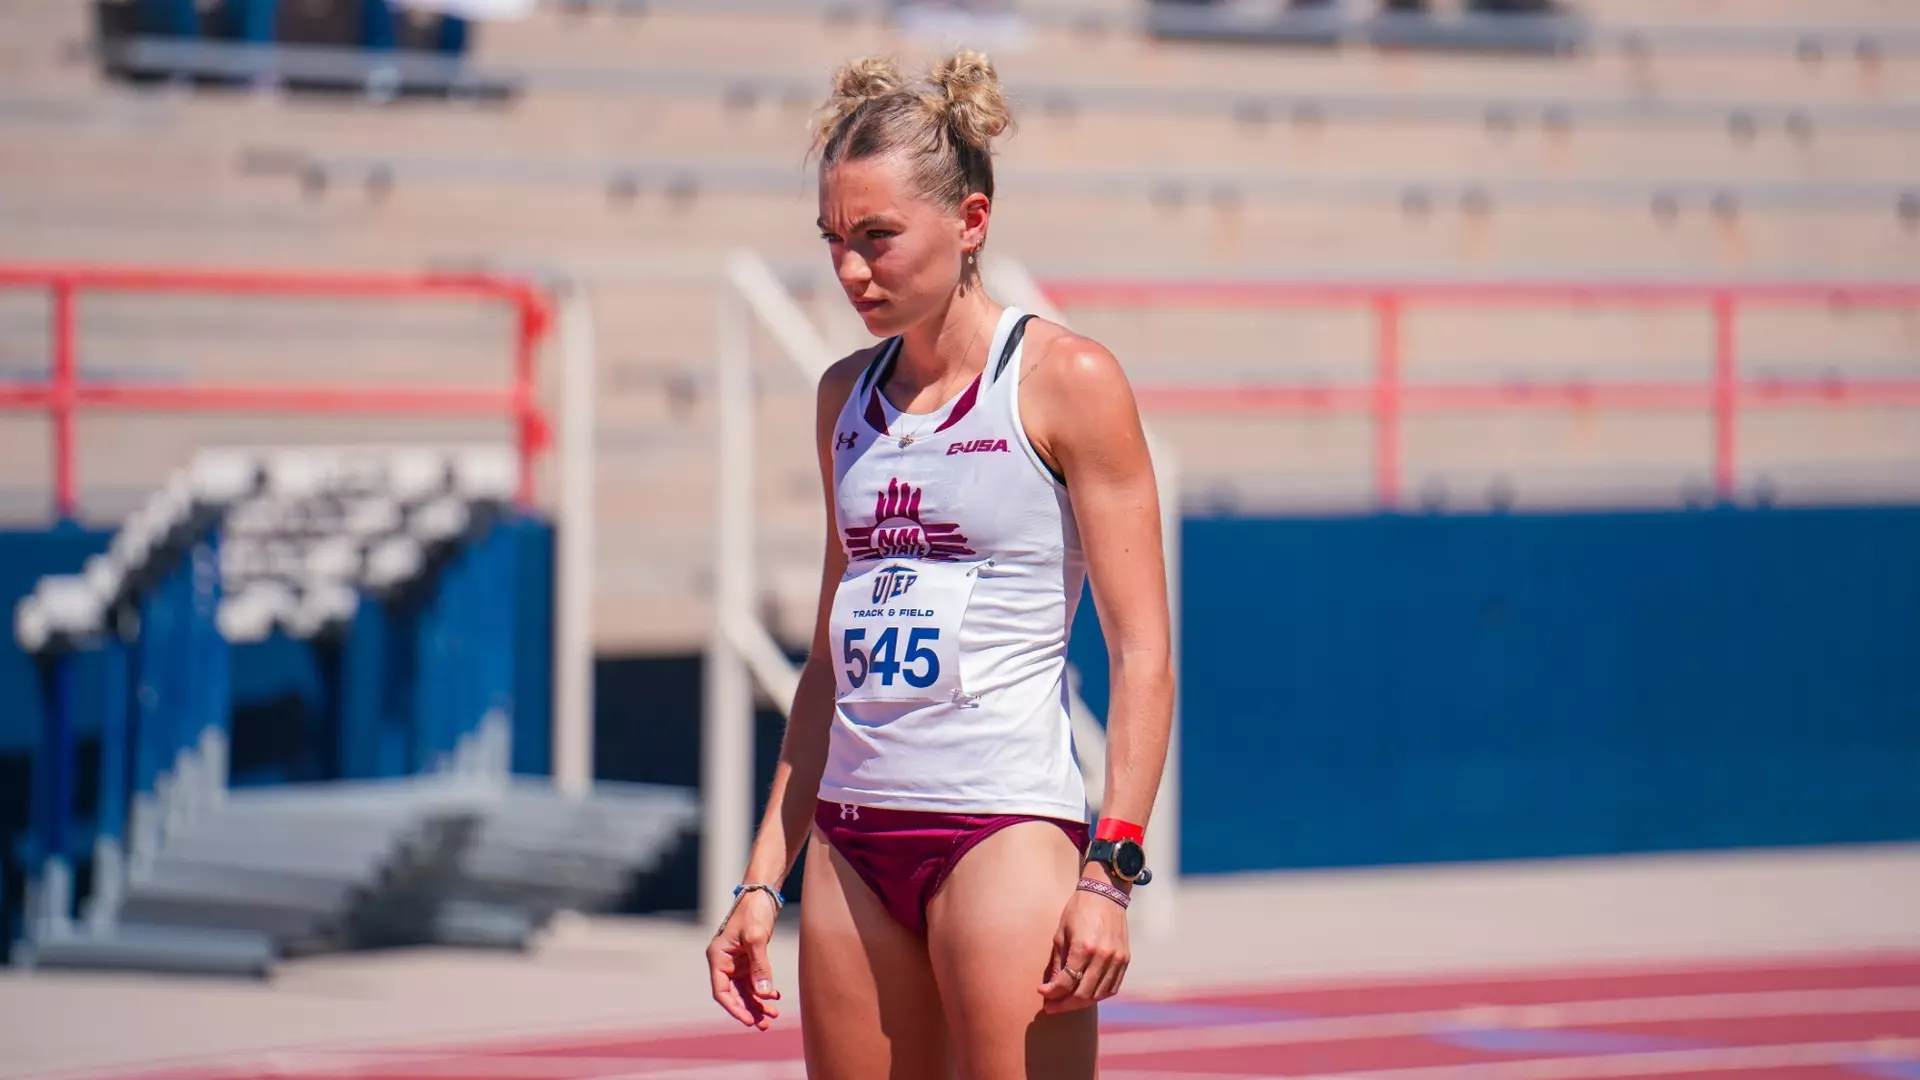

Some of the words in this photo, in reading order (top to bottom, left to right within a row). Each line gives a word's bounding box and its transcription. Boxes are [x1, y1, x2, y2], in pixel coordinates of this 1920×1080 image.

[878, 528, 920, 547] NM
[872, 563, 917, 604] UTEP
[853, 609, 884, 618] TRACK
[888, 609, 896, 617] &
[899, 609, 934, 617] FIELD
[843, 627, 940, 689] 545
